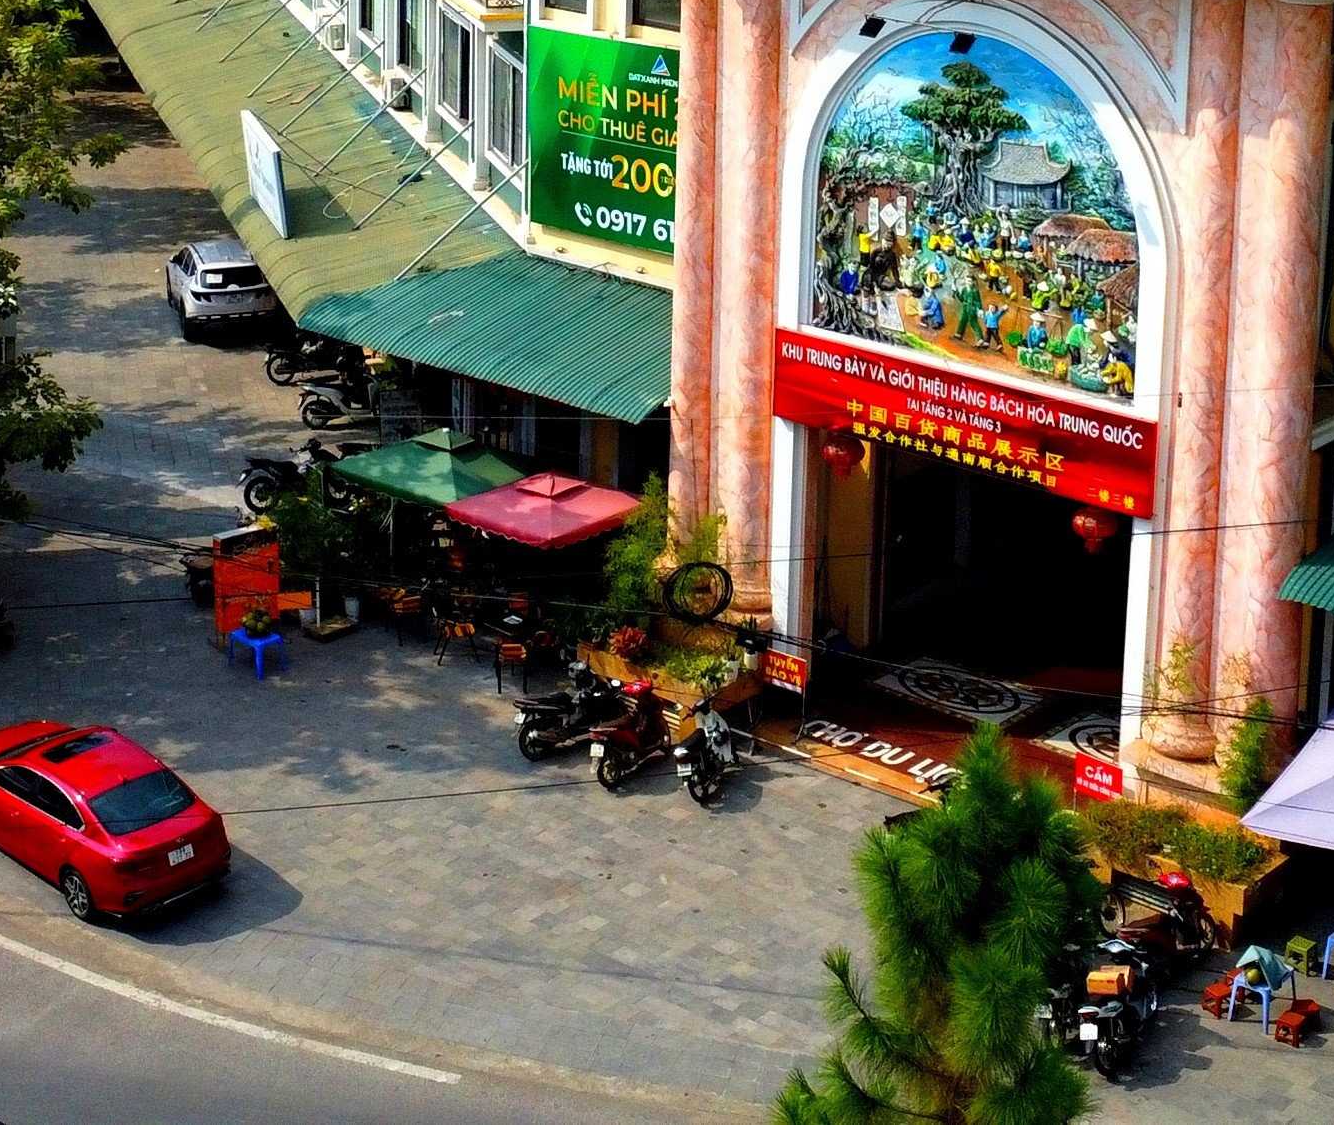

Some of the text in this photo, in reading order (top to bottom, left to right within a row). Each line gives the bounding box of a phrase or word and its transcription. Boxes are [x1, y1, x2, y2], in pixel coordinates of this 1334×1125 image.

[626, 88, 669, 119] PHÍ
[558, 110, 596, 133] CHO
[599, 117, 647, 143] THUÊ
[561, 150, 592, 175] TẶNG
[593, 158, 614, 180] TỚI
[596, 206, 647, 237] 0917
[781, 341, 804, 362] KHU
[844, 354, 867, 378] BÀY
[869, 360, 886, 383] VÀ
[888, 367, 915, 391] GIỚI
[918, 374, 948, 400] THIỆU
[950, 381, 987, 409] HÀNG
[989, 392, 1024, 419] BÁCH
[1026, 403, 1055, 428] HÓA
[1058, 411, 1100, 439] TRUNG
[1102, 423, 1144, 450] QUỐC
[906, 397, 920, 413] TẠI
[947, 408, 953, 421] 2
[954, 407, 968, 425] VÀ
[995, 420, 1002, 434] 3
[847, 398, 1065, 472] 中国百货商品展示区
[860, 740, 917, 766] DU
[906, 757, 963, 787] LỊC
[1084, 765, 1113, 787] CẤM
